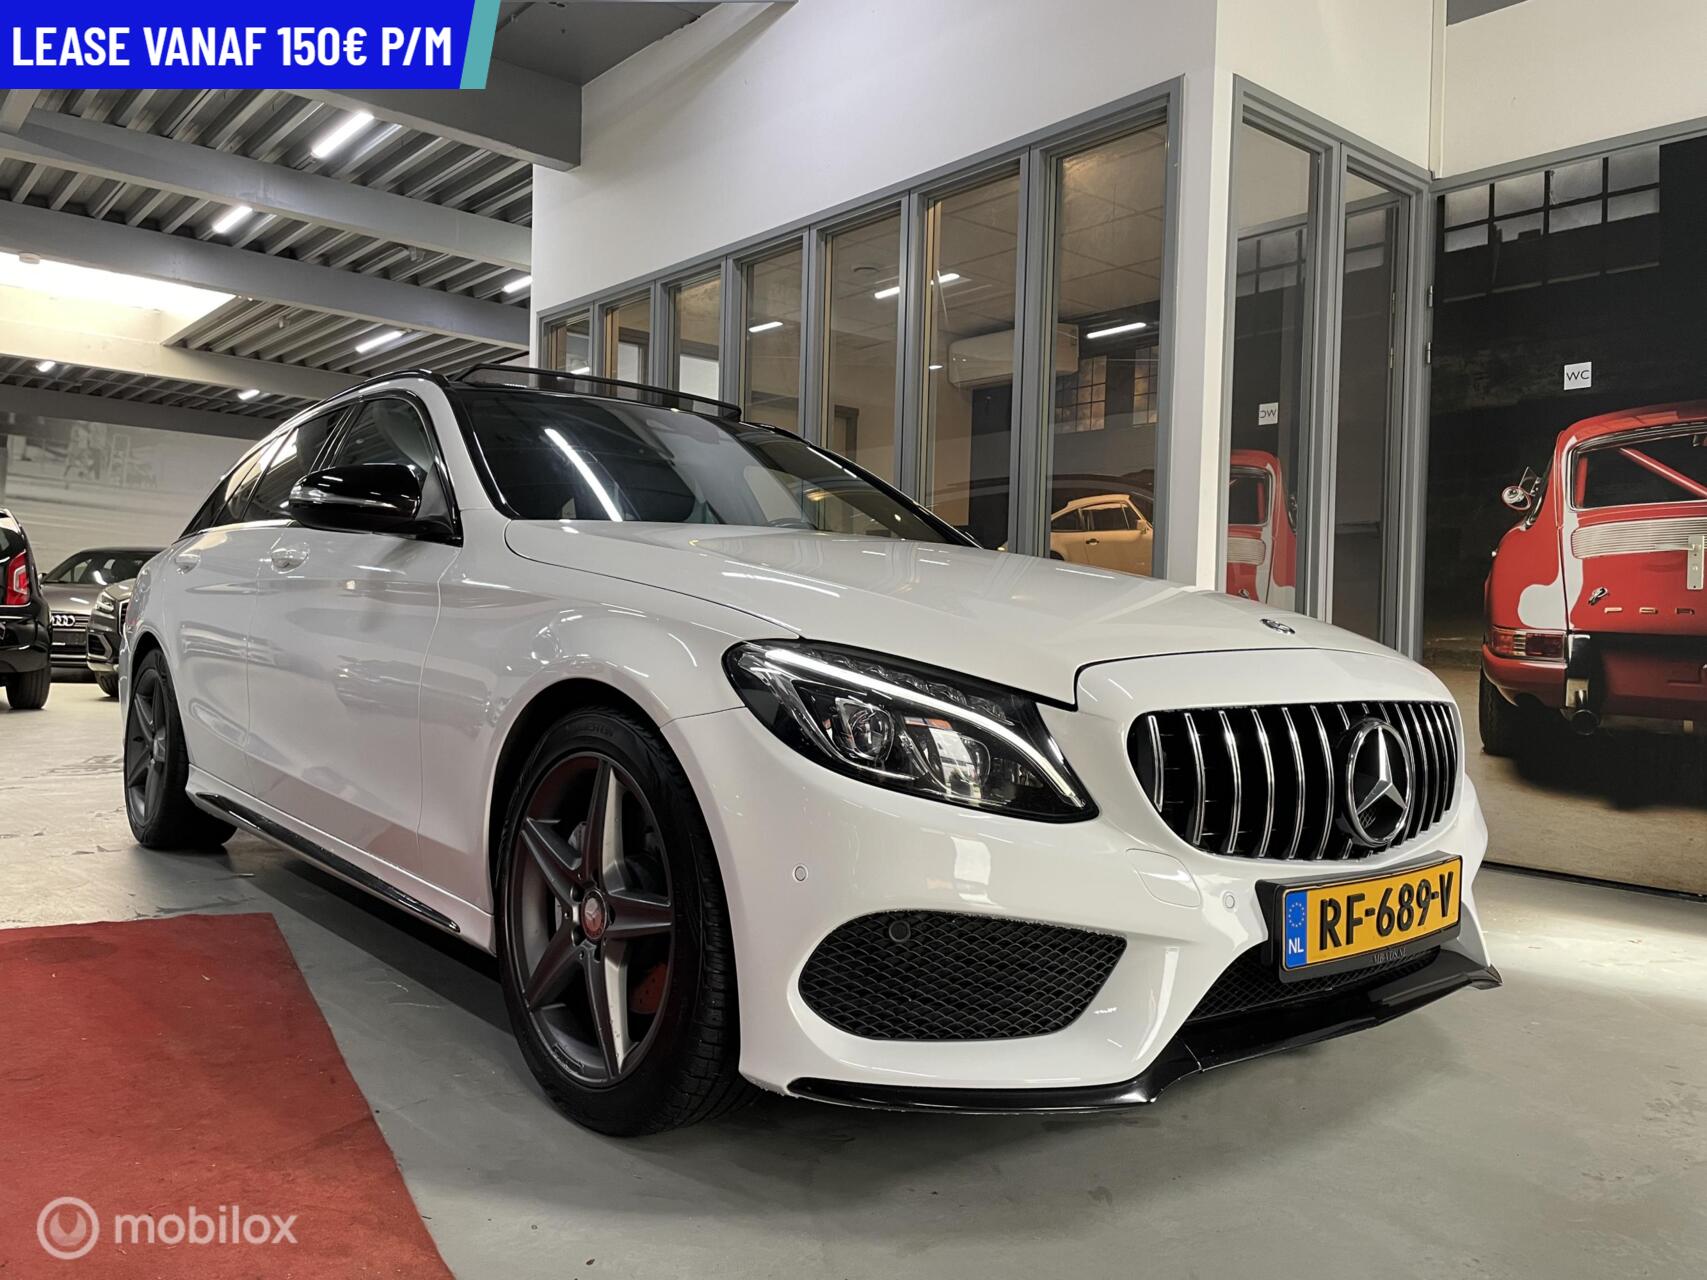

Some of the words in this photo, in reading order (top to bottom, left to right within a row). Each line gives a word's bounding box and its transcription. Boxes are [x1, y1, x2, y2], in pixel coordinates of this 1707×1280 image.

[1566, 369, 1590, 381] WC
[1288, 937, 1305, 955] NL
[1318, 870, 1454, 952] RF-689-V
